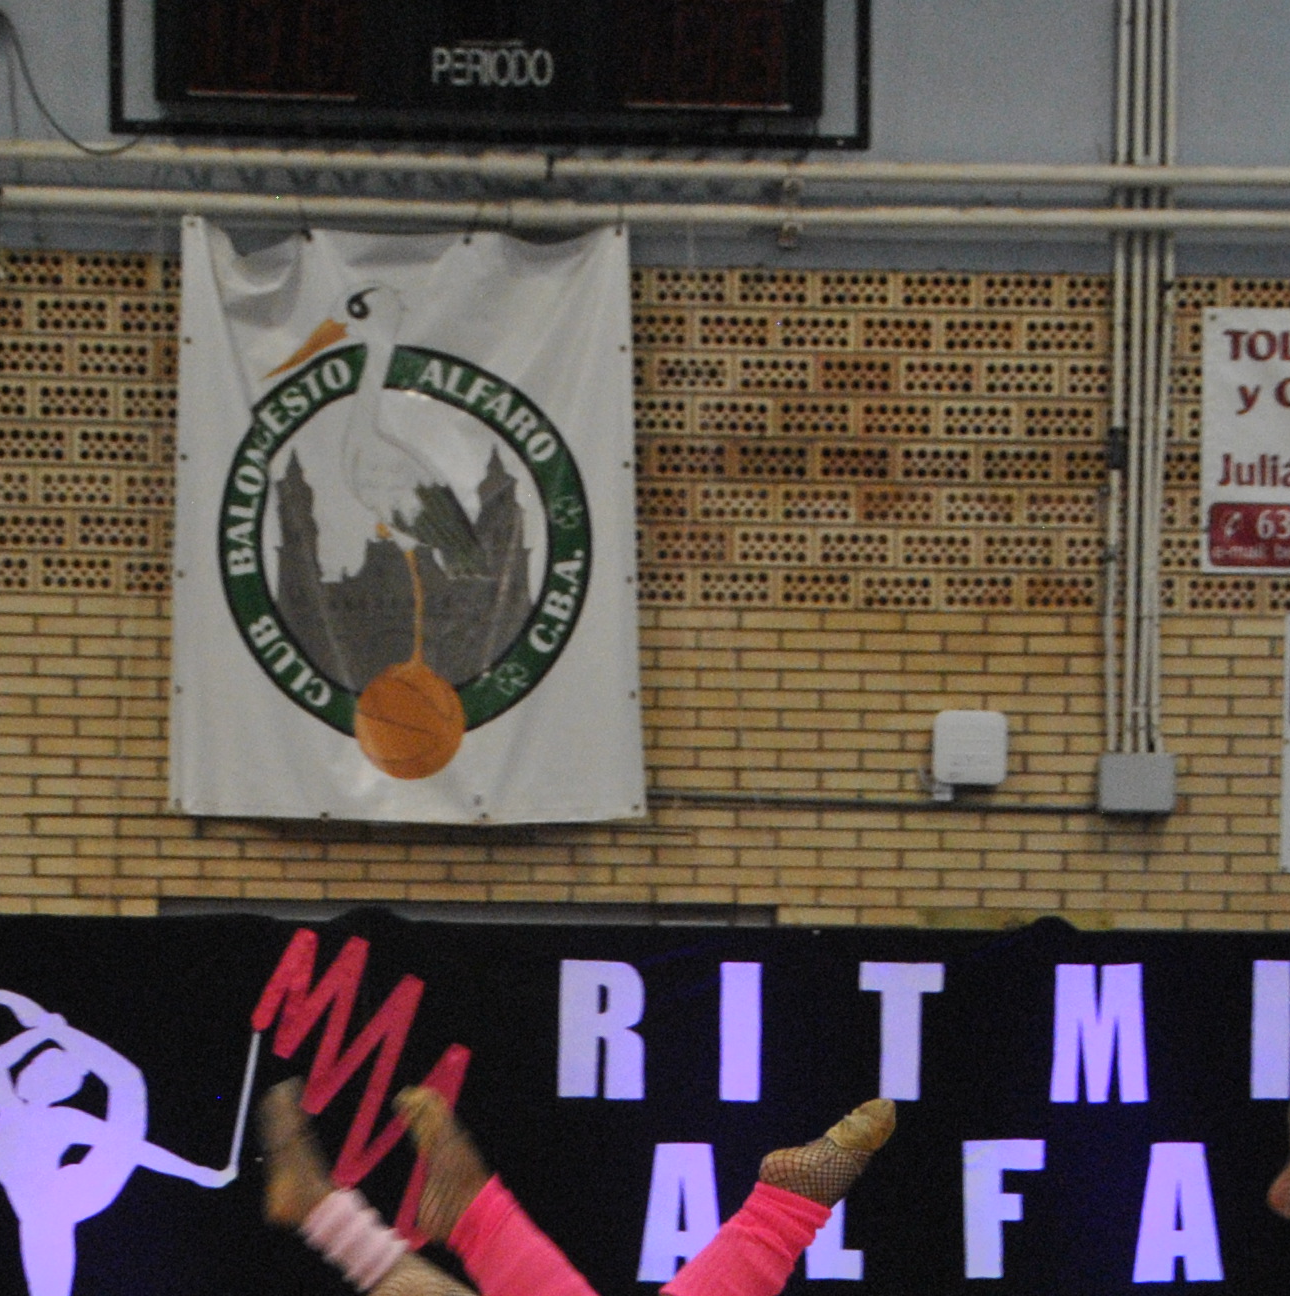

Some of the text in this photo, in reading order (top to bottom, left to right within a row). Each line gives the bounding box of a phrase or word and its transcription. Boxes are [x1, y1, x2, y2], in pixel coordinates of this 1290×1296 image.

[432, 47, 554, 87] PERIODO
[1236, 384, 1261, 415] y
[247, 614, 333, 708] CLUB
[418, 359, 557, 463] ALFARO
